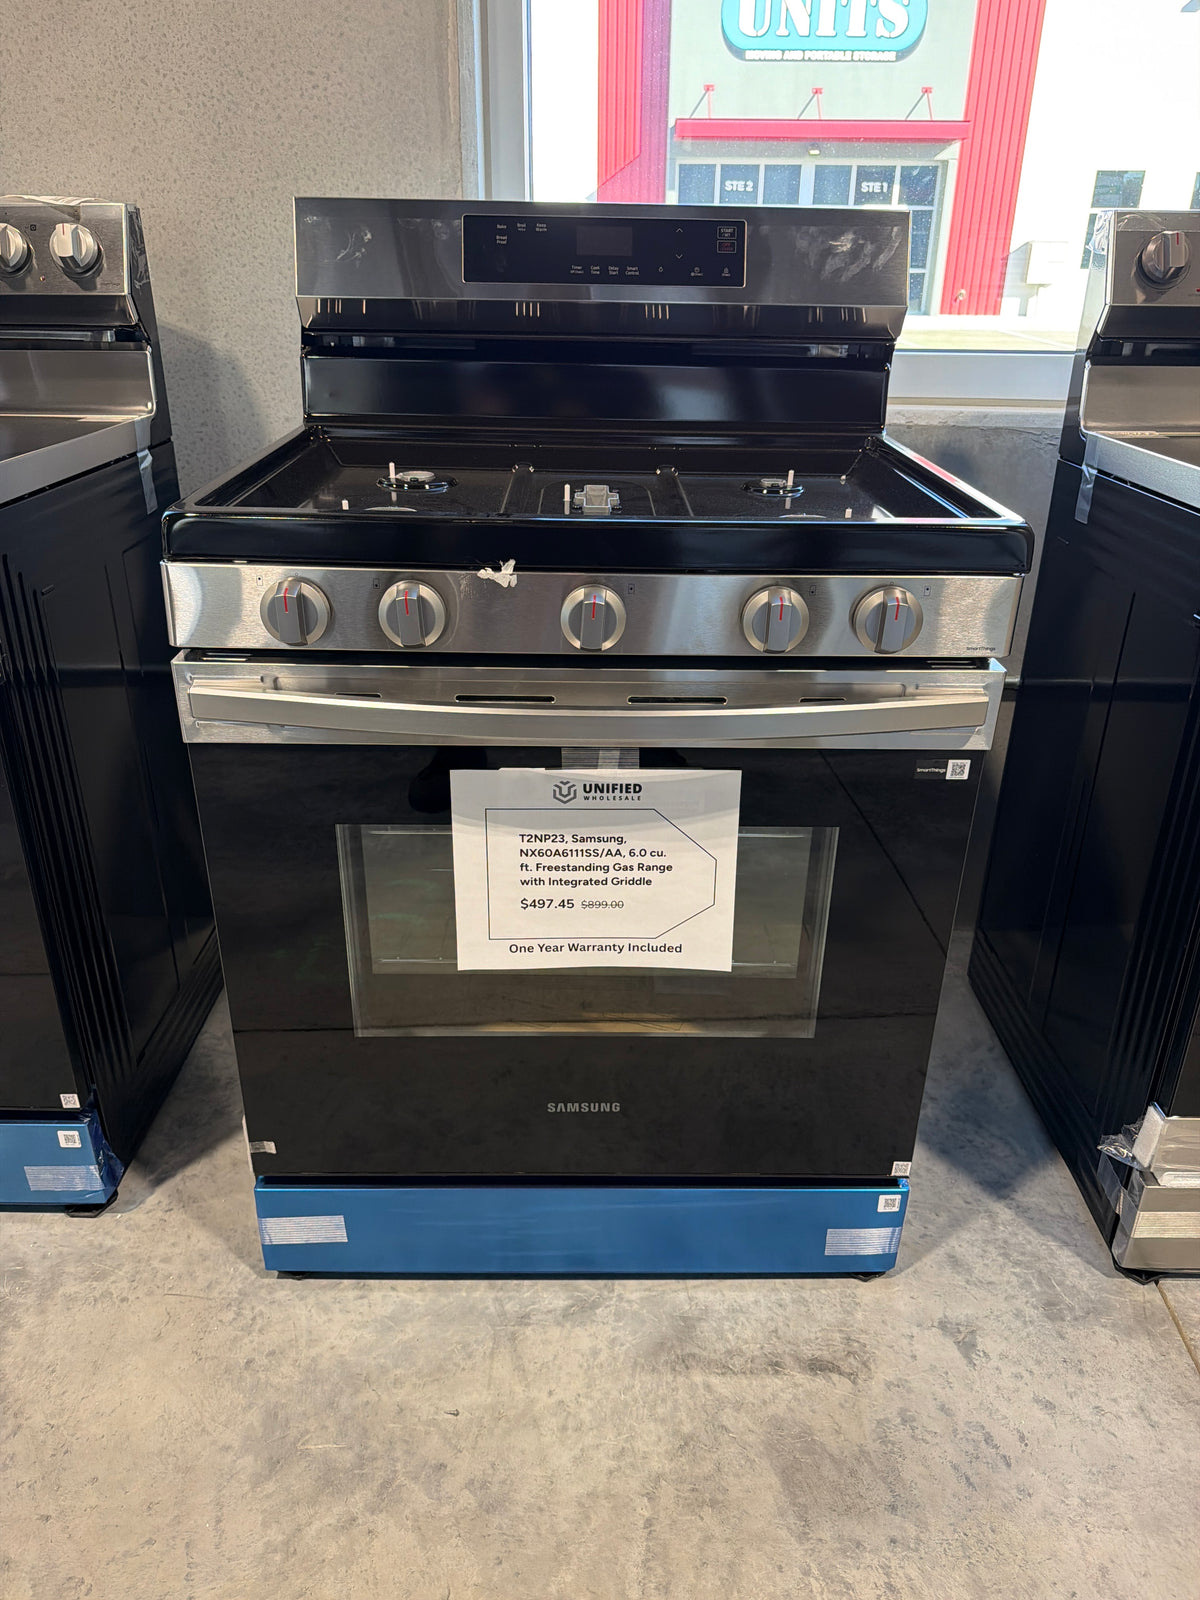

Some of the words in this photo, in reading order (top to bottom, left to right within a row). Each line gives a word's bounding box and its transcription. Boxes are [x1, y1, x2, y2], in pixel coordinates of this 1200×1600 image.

[738, 0, 909, 38] UNITS
[783, 50, 803, 60] AND
[804, 50, 851, 61] PORTABLE
[852, 51, 896, 61] STORAGE
[725, 181, 744, 191] STE
[746, 181, 753, 191] 2
[861, 182, 880, 192] STE
[882, 182, 888, 192] 1
[583, 783, 642, 794] UNIFIED
[519, 834, 569, 844] T2NP23,
[571, 834, 627, 845] Samsung,
[519, 848, 626, 859] NX60A6111SS/AA,
[629, 849, 647, 858] 6.0
[650, 850, 667, 858] cu.
[520, 862, 533, 872] ft.
[536, 863, 610, 874] Freestanding
[613, 863, 634, 872] Gas
[637, 863, 673, 874] Range
[520, 877, 545, 886] with
[548, 877, 608, 888] Integrated
[611, 877, 652, 886] Griddle
[520, 898, 575, 910] $497.45
[581, 900, 624, 909] $899.00
[509, 943, 534, 953] One
[537, 943, 564, 953] Year
[568, 943, 625, 954] Warranty
[628, 943, 683, 953] Included
[547, 1102, 620, 1112] SAMSUNG
